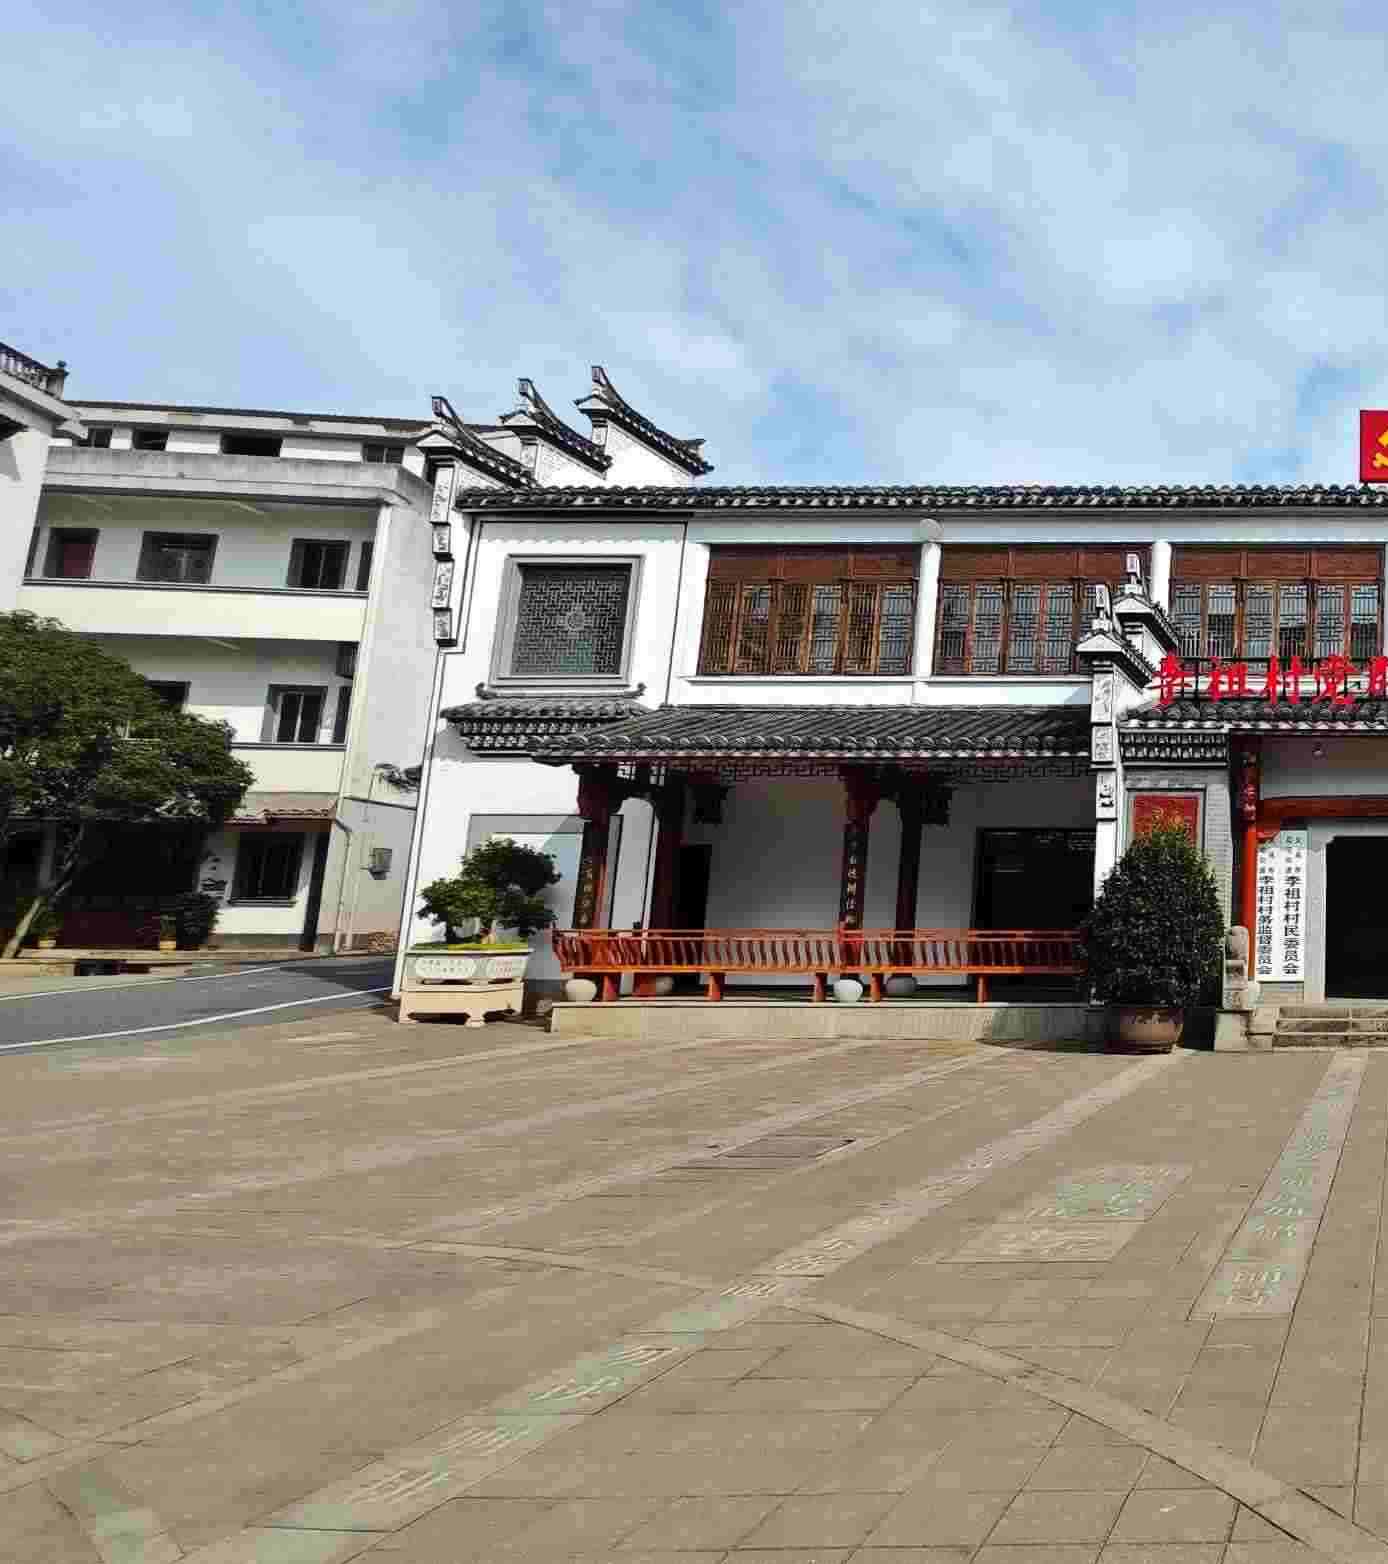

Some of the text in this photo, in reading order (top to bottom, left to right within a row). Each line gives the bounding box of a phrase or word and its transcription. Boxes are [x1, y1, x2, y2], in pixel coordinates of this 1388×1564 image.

[1282, 875, 1301, 975] 李祖村村民委员会
